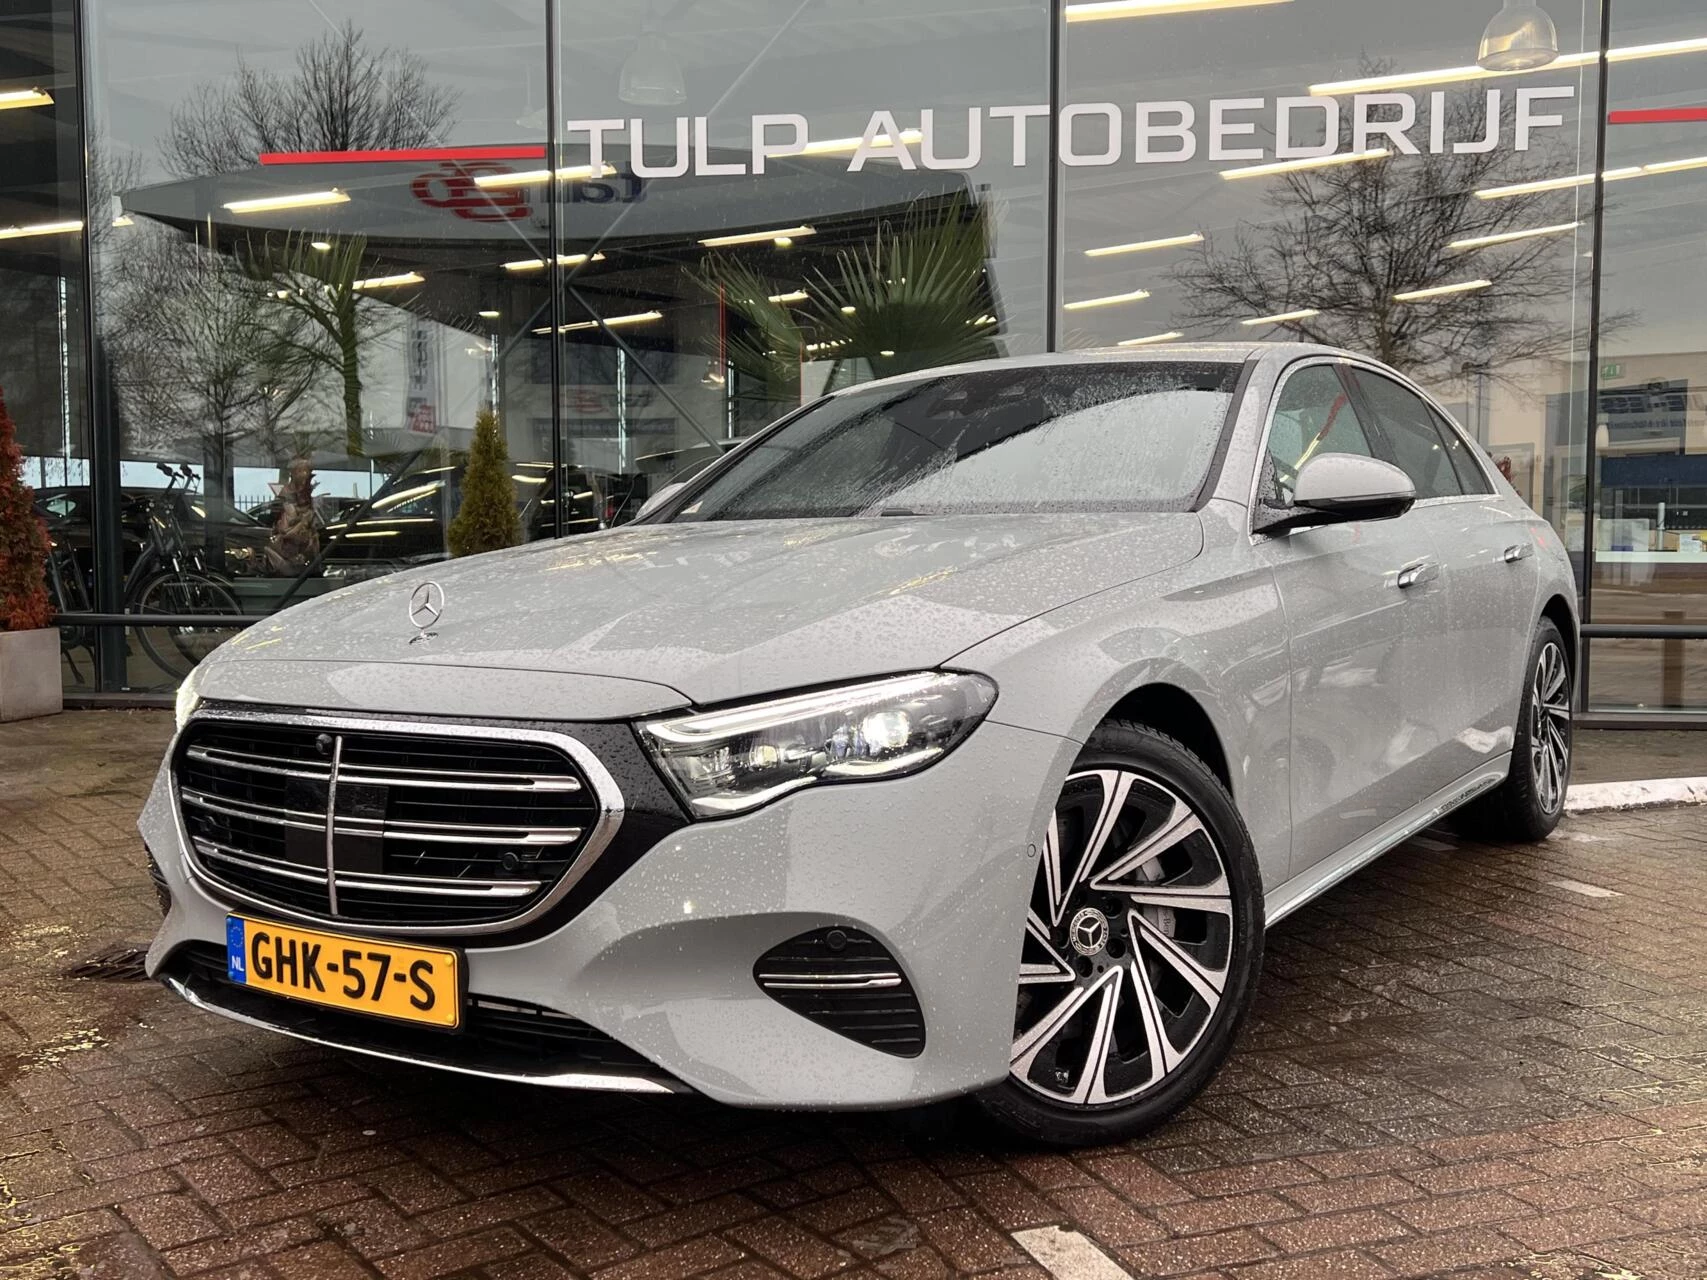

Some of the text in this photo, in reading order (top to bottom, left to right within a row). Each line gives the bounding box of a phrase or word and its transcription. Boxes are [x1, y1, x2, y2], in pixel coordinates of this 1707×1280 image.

[567, 86, 1574, 178] TULP AUTOBEDRIJF
[231, 955, 244, 972] NL
[252, 932, 435, 1011] GHK-57-S
